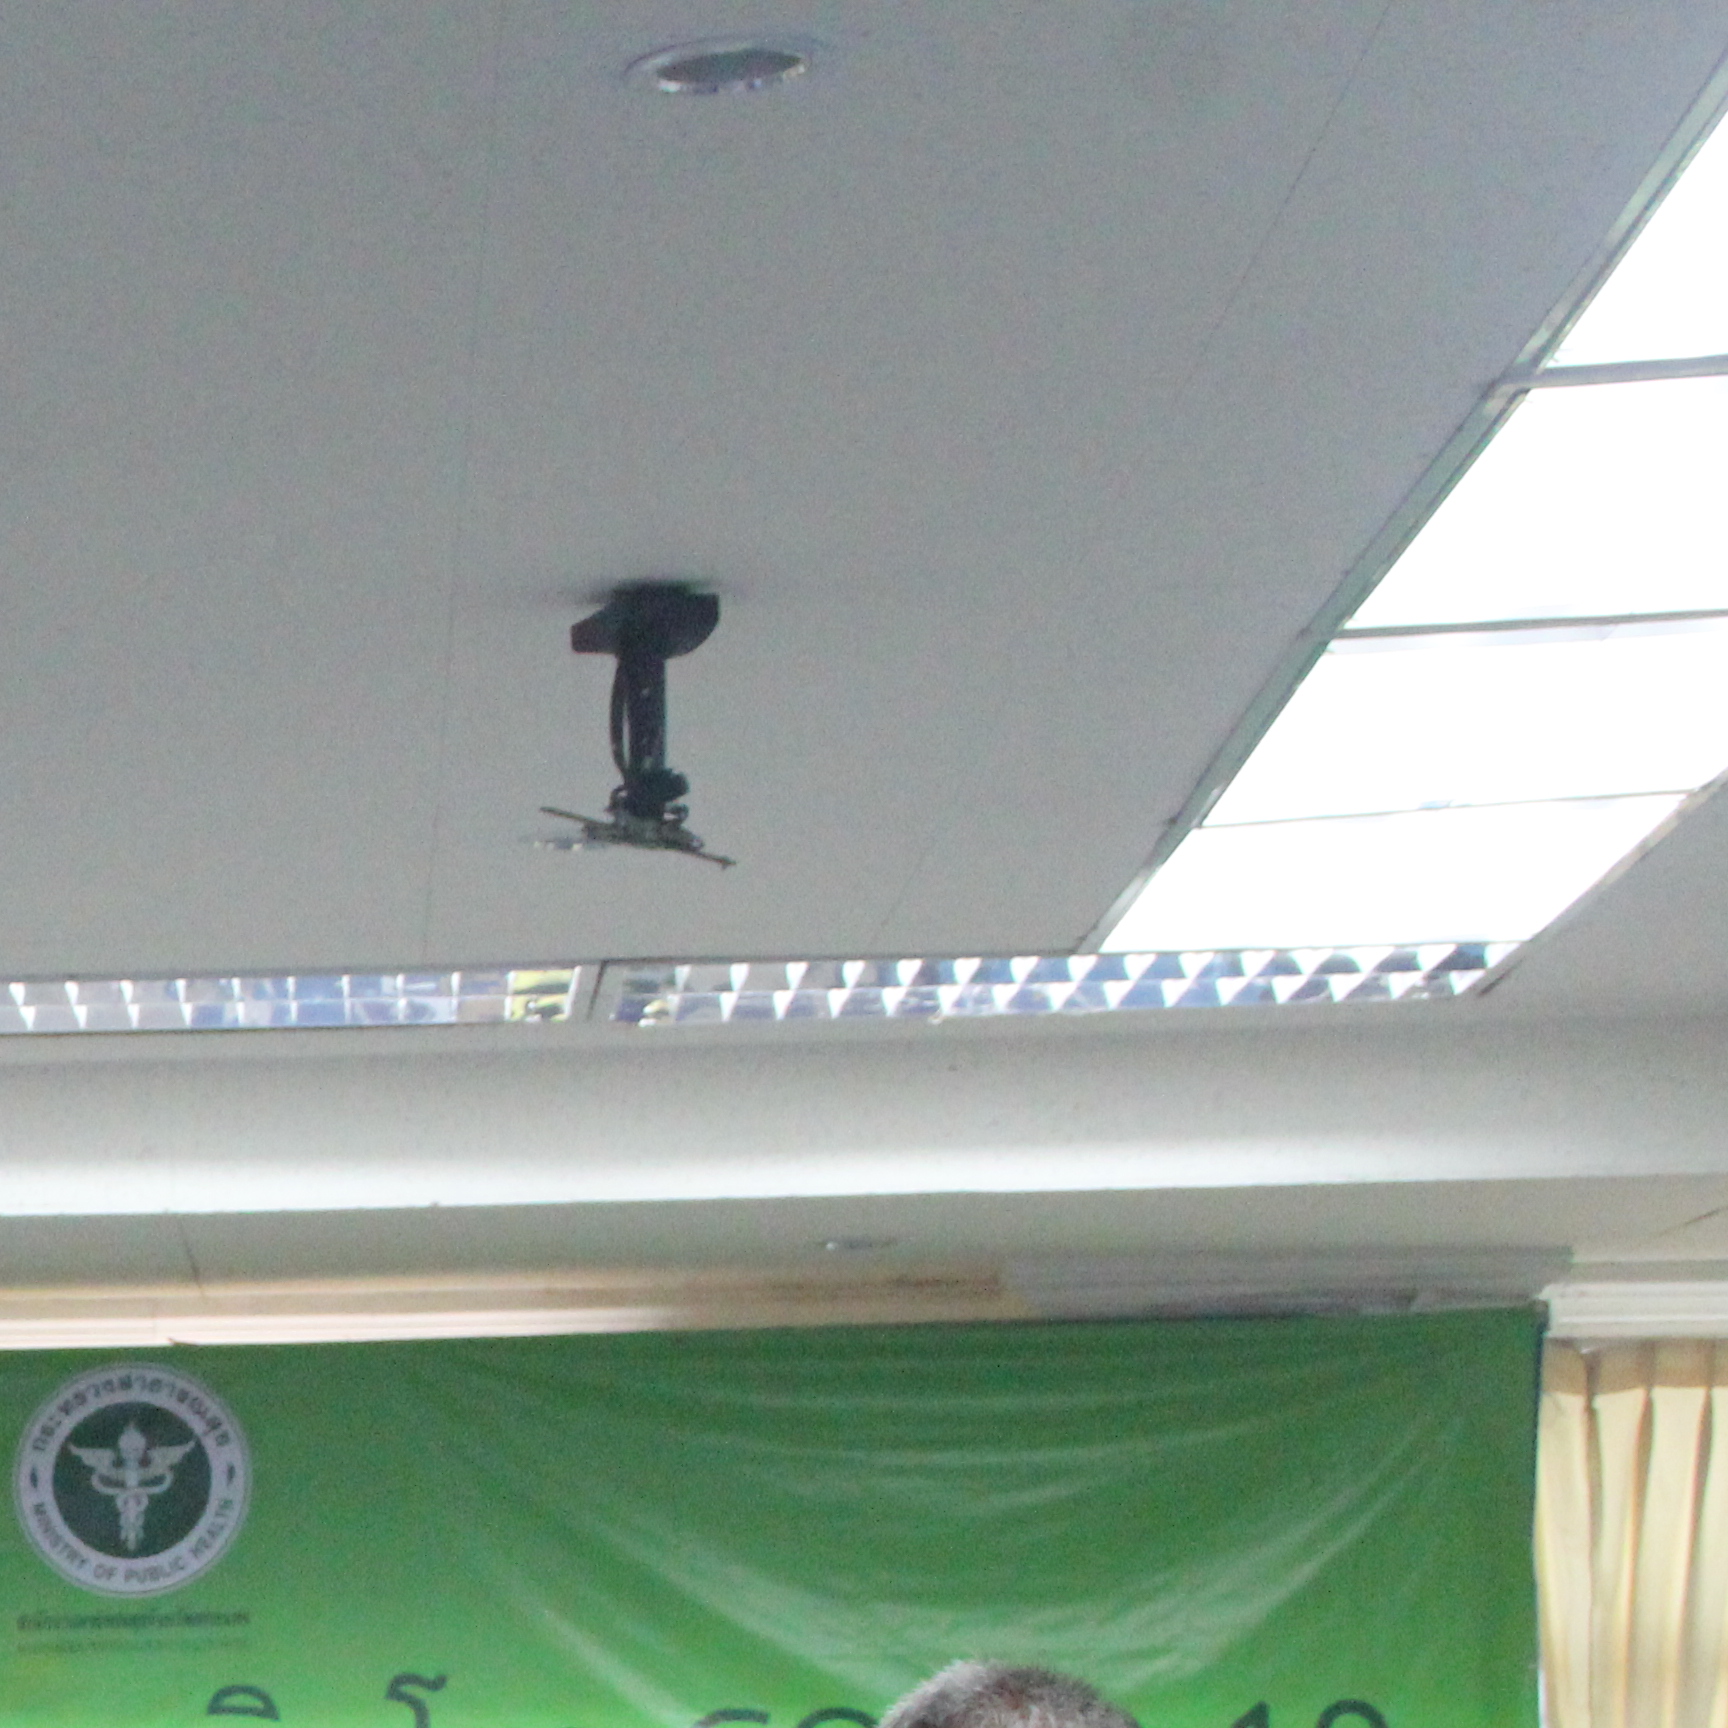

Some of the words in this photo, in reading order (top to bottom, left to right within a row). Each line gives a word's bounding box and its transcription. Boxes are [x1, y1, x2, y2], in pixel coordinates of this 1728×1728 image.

[33, 1502, 88, 1569] MINISTRY
[94, 1563, 118, 1581] OF
[123, 1555, 186, 1583] PUBLIC
[191, 1498, 233, 1558] HEALTH
